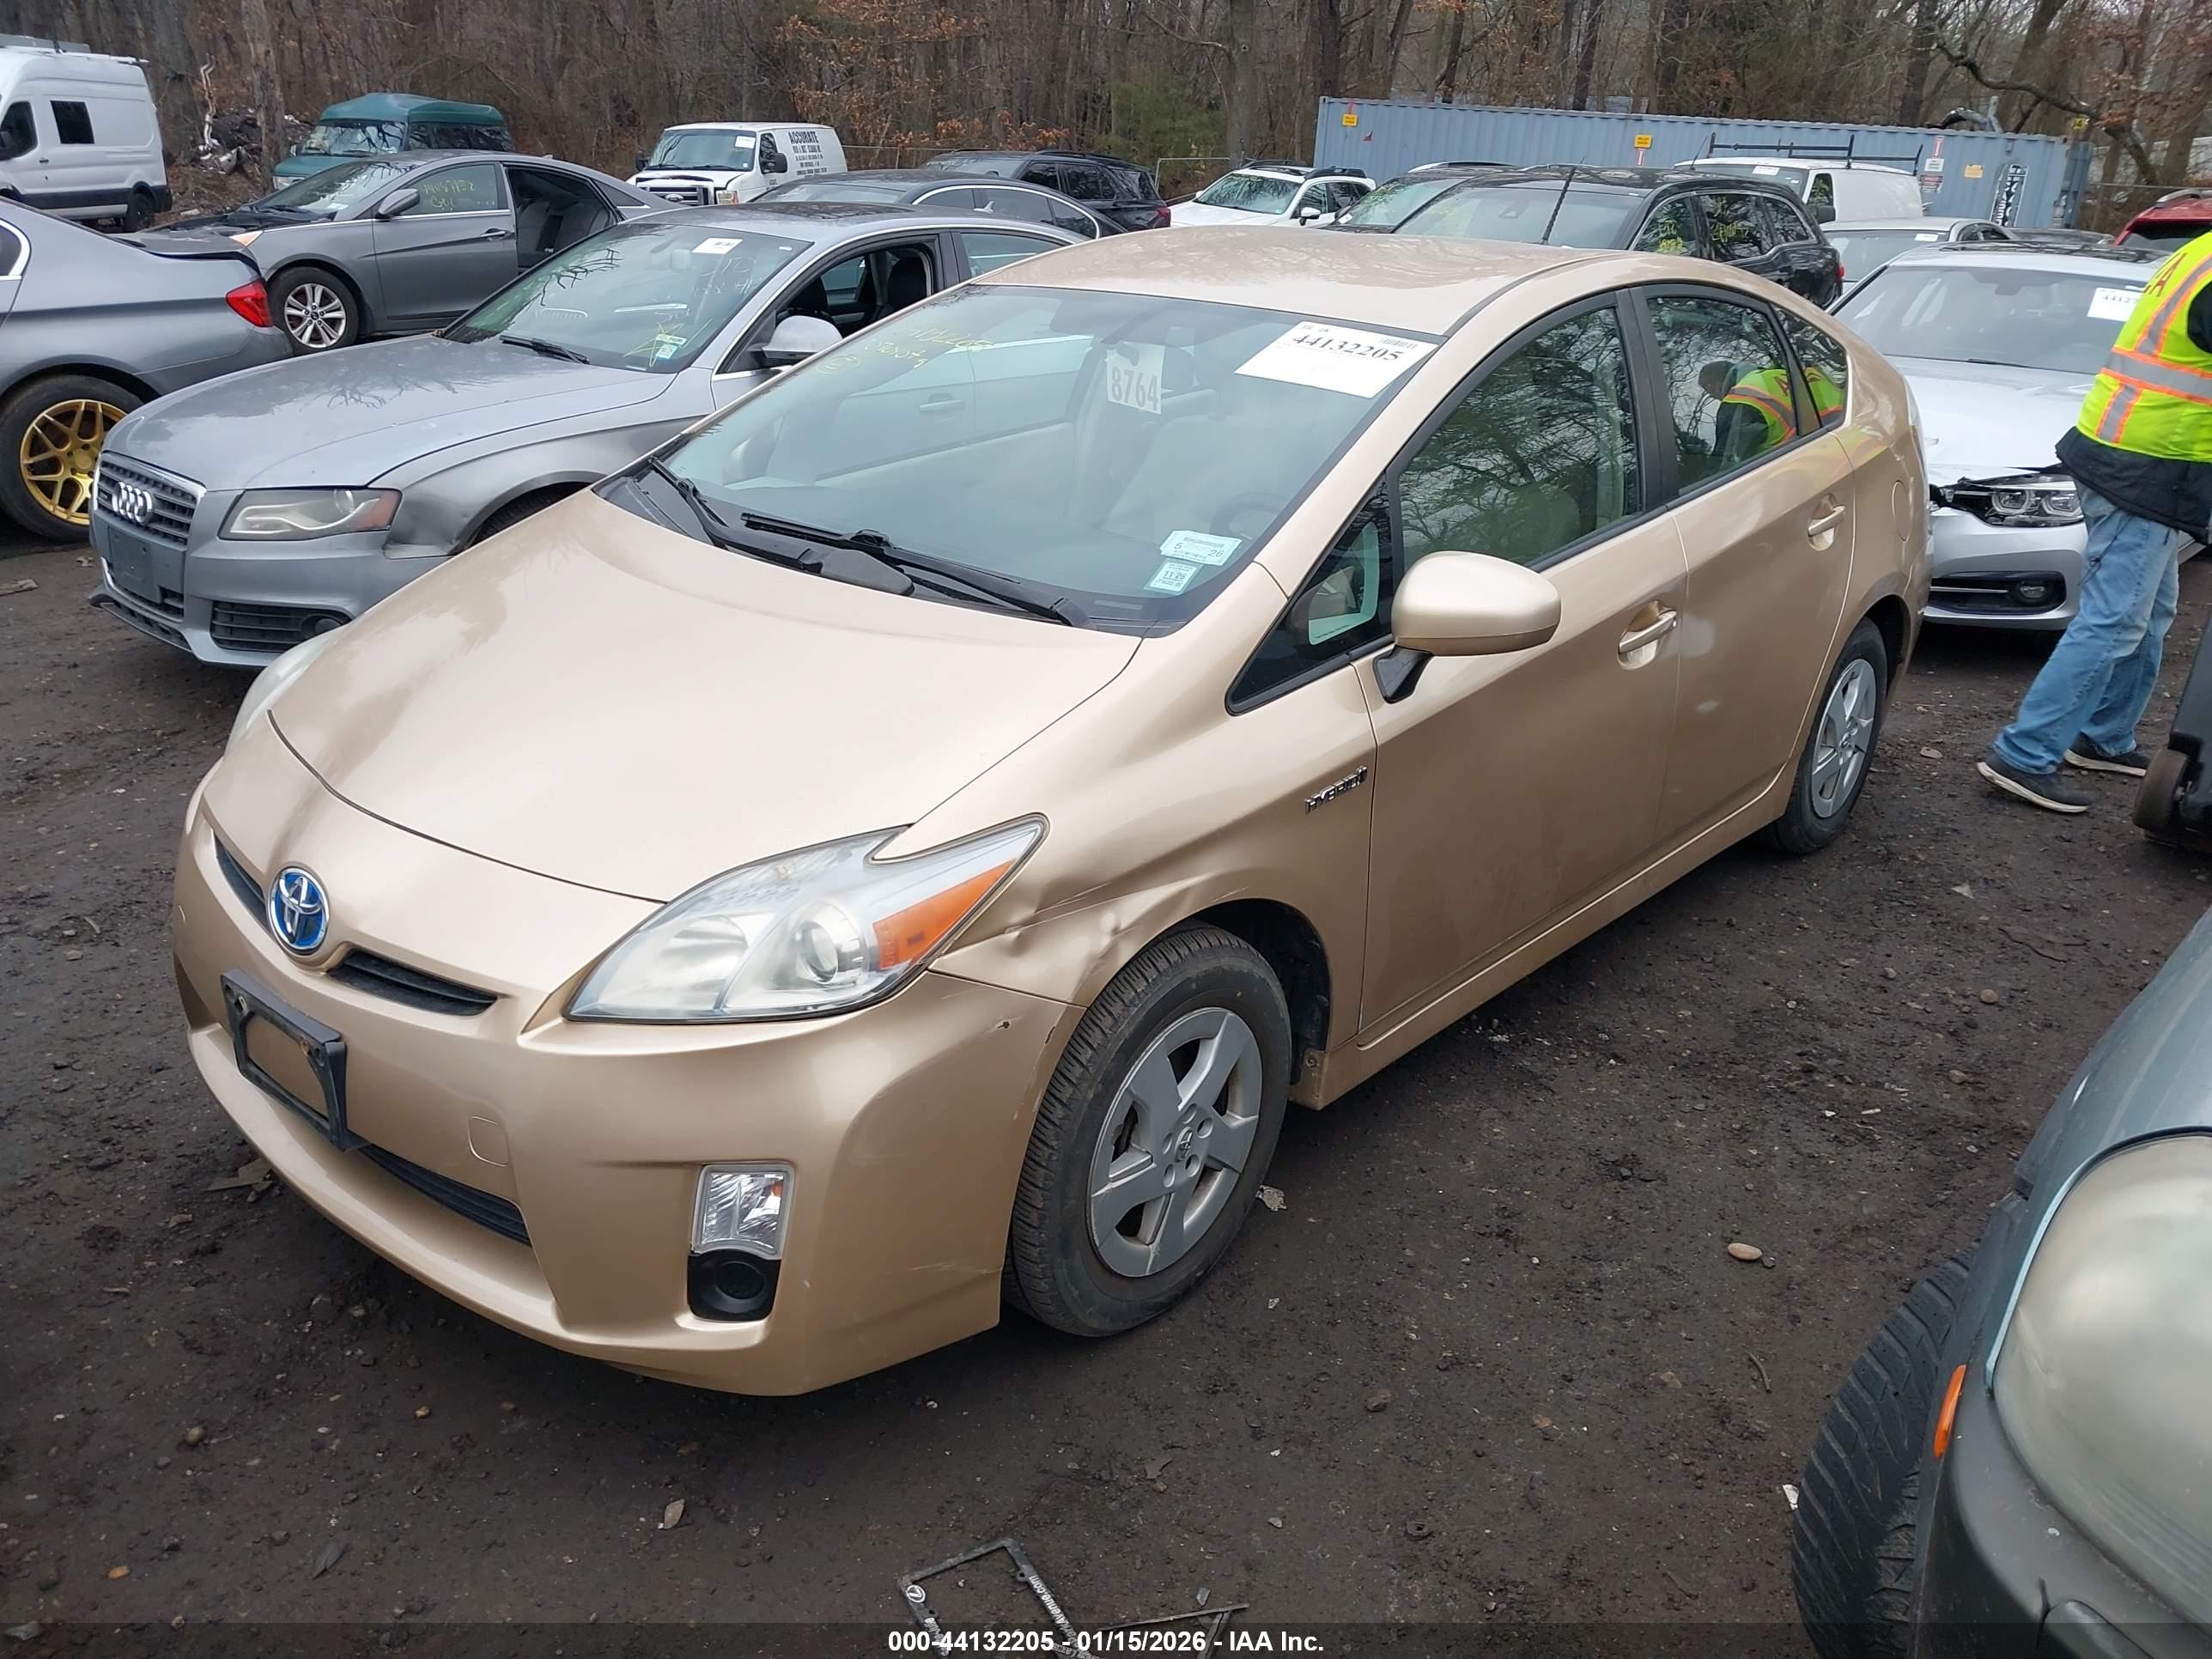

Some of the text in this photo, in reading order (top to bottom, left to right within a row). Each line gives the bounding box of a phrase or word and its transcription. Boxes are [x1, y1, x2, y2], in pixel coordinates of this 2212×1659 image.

[787, 131, 819, 144] ACCURATE
[1293, 335, 1404, 361] 44132205
[1111, 365, 1159, 411] 8764
[1174, 542, 1182, 550] 5
[1207, 550, 1224, 558] 26
